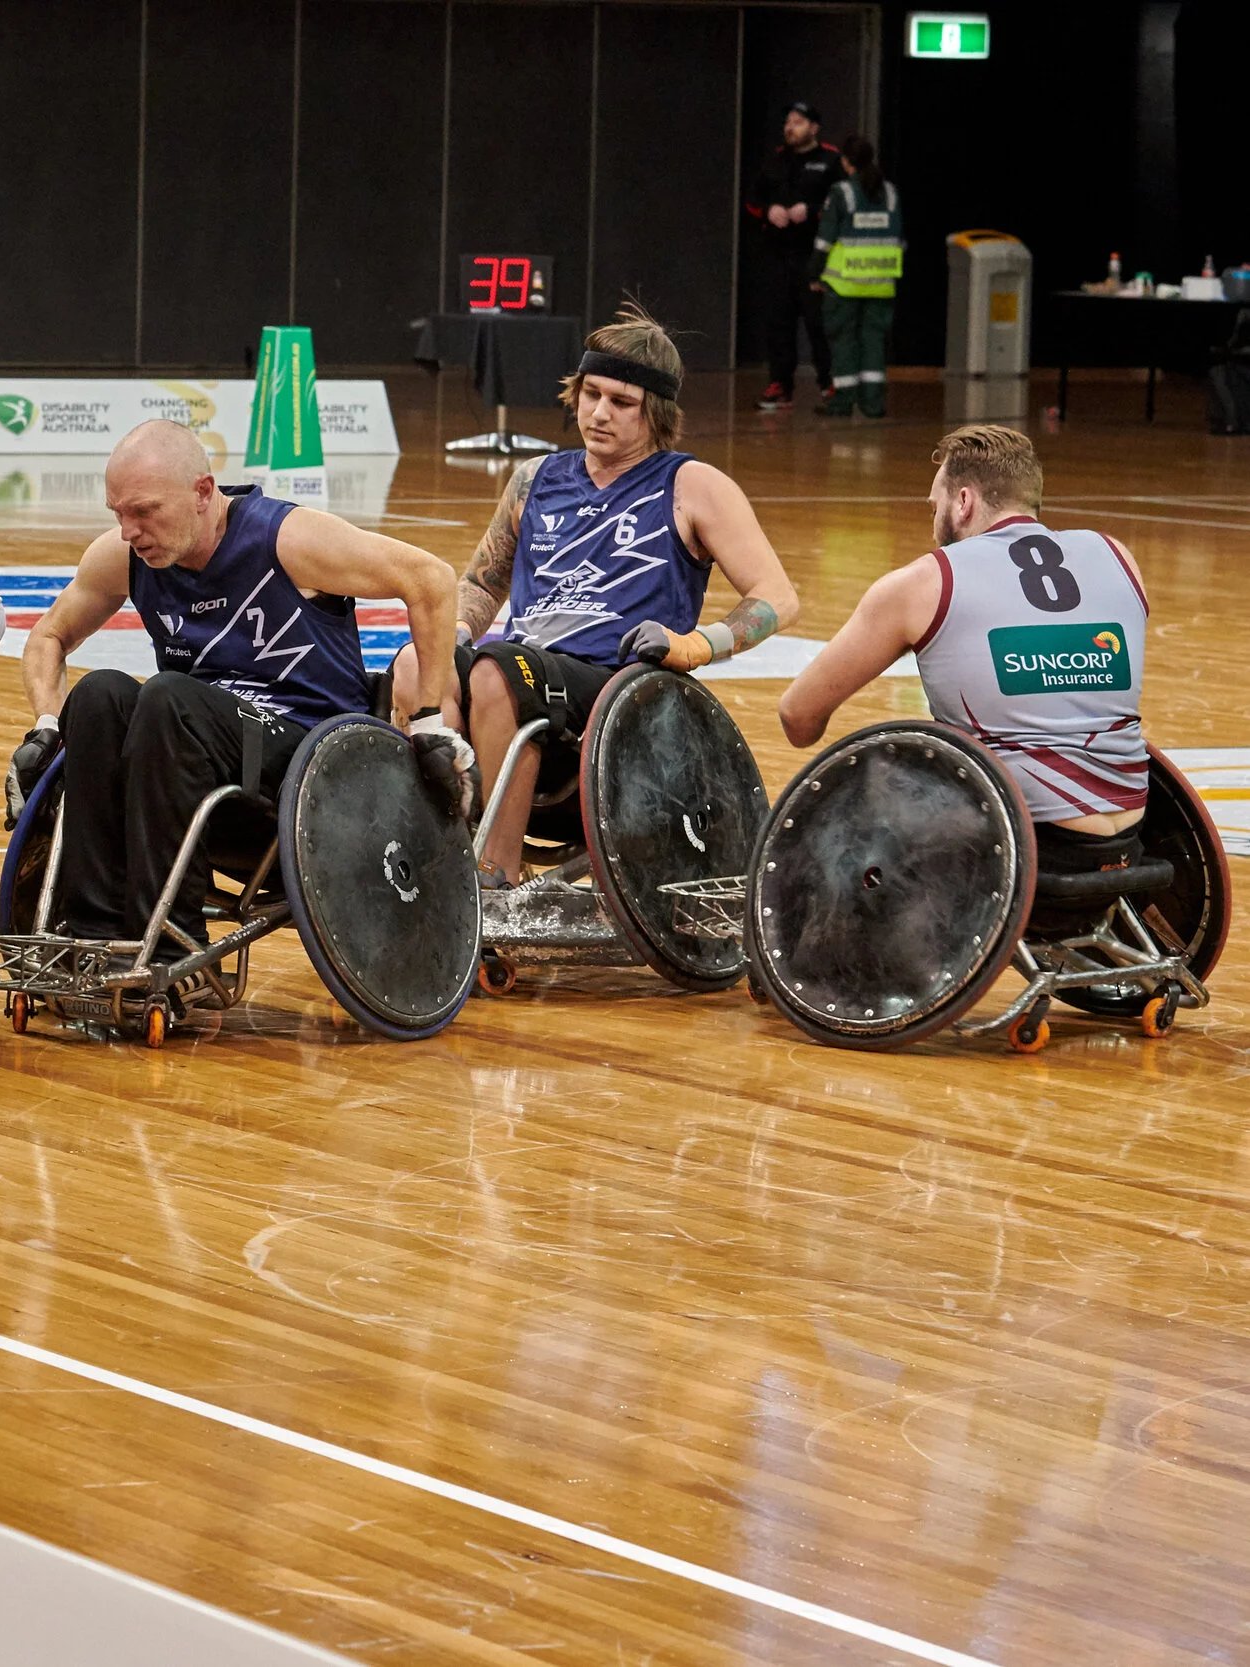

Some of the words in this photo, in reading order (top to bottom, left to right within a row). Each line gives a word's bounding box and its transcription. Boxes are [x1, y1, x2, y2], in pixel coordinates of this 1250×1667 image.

[470, 258, 531, 309] 39
[41, 403, 110, 413] DISABILITY
[141, 398, 208, 408] CHANGING
[318, 404, 368, 413] ABILITY
[41, 414, 96, 423] SPORTS
[319, 415, 354, 424] ORTS
[41, 423, 111, 433] AUSTRALIA
[320, 424, 368, 433] STRALIA
[614, 513, 638, 546] 6
[1008, 534, 1081, 613] 8
[524, 600, 607, 616] THUNDER
[246, 607, 266, 648] 7
[165, 646, 192, 657] Protect
[1004, 652, 1113, 673] SUNCORP
[1042, 672, 1113, 687] Insurance
